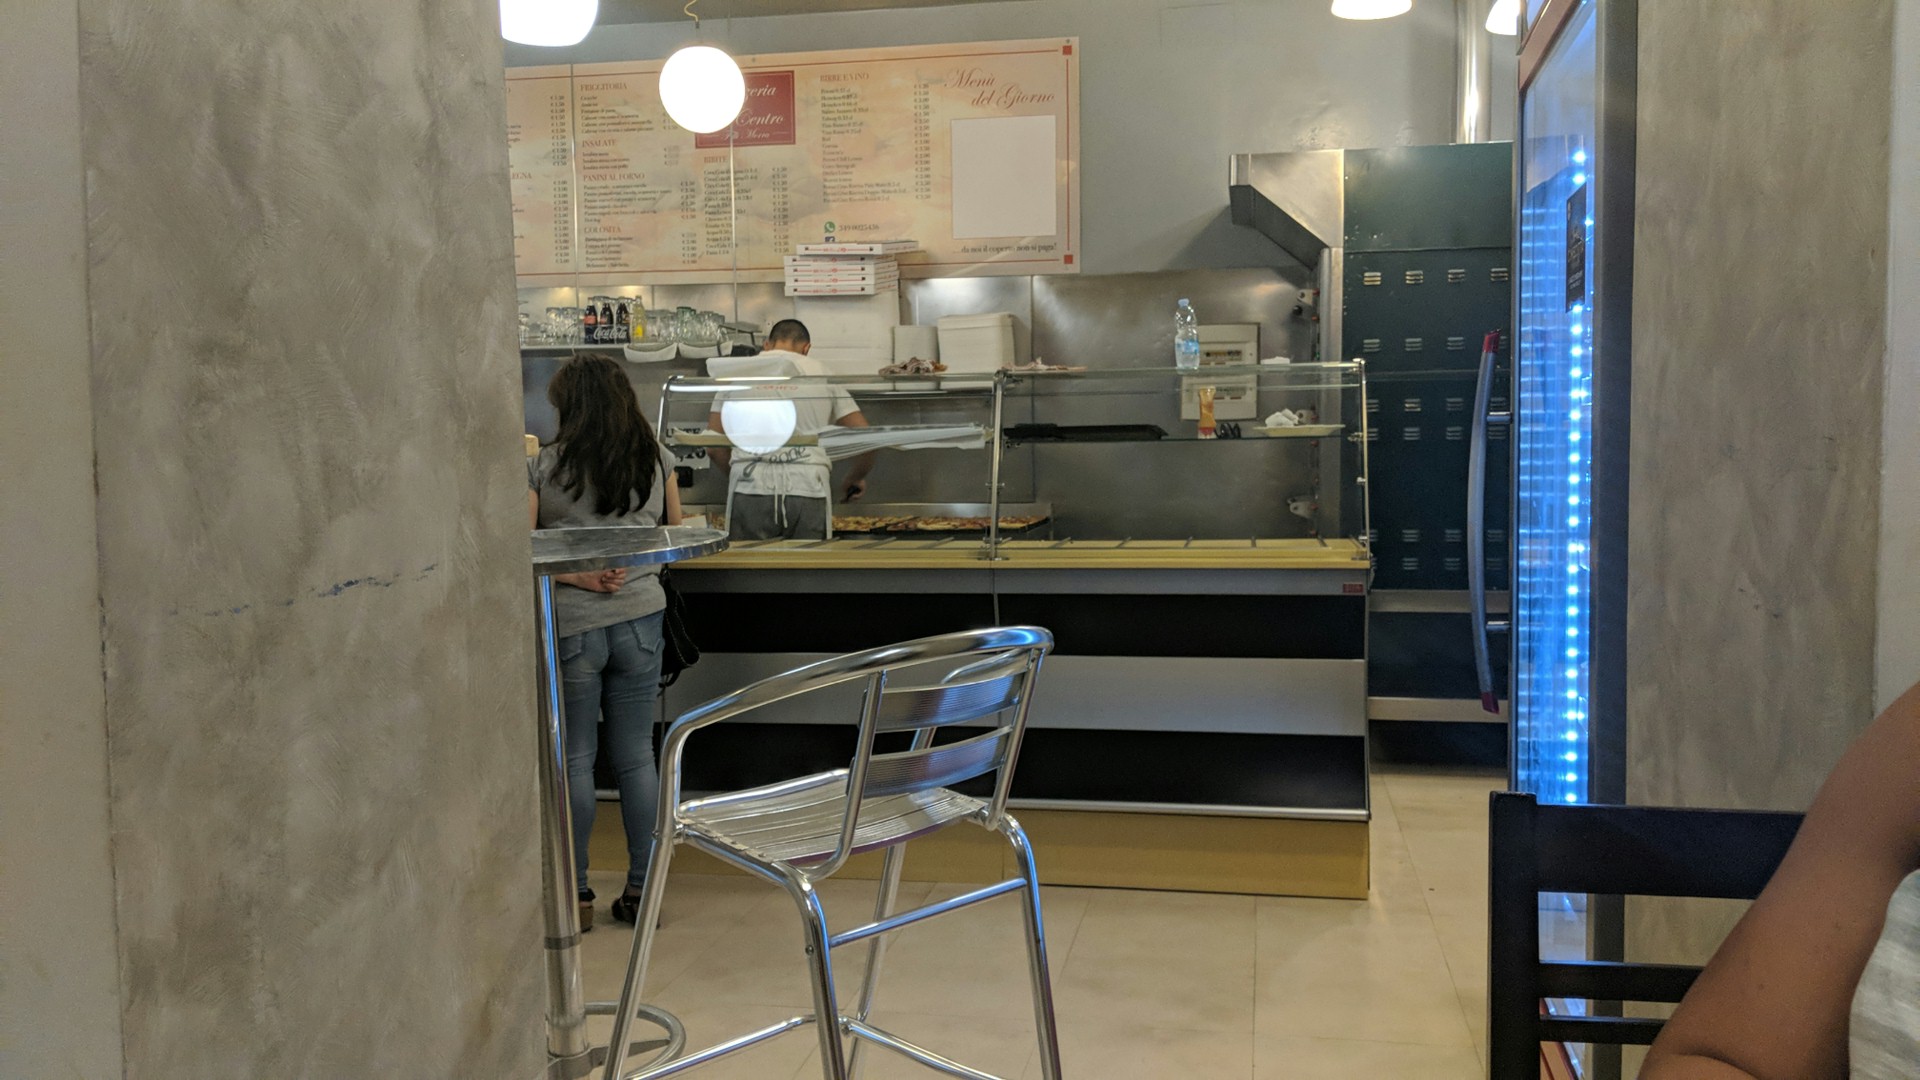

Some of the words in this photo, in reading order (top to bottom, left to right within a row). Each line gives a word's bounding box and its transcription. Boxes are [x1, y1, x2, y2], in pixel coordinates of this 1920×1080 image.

[944, 67, 995, 88] Menù
[971, 90, 996, 105] del
[996, 82, 1055, 109] Giorno
[735, 108, 784, 127] Centro
